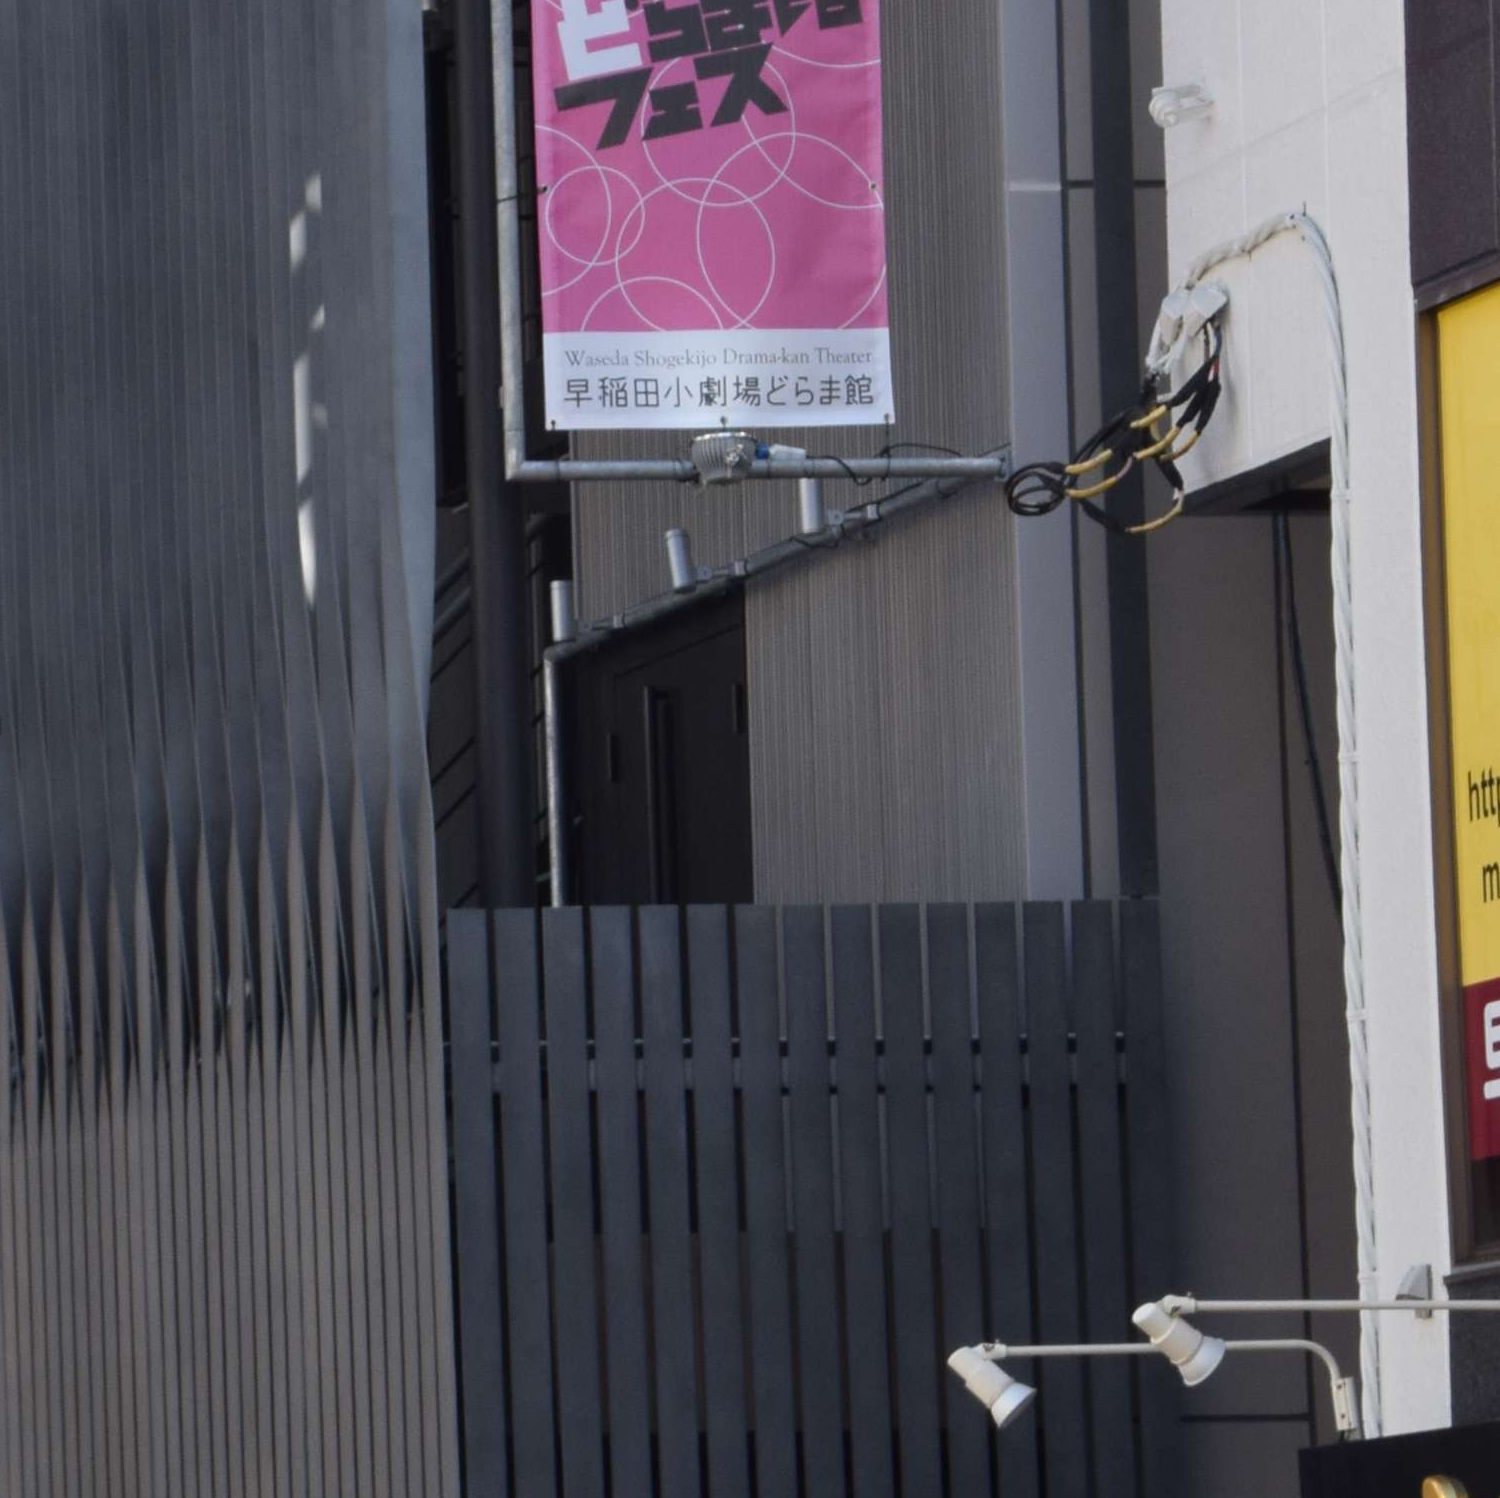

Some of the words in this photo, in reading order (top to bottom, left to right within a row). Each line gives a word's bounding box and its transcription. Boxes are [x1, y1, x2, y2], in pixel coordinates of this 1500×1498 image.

[553, 42, 789, 150] フェス
[565, 350, 629, 367] Waseda
[634, 349, 716, 369] Shogekijo
[814, 347, 873, 364] Theater
[564, 373, 874, 408] 早稲田小劇場どらま館
